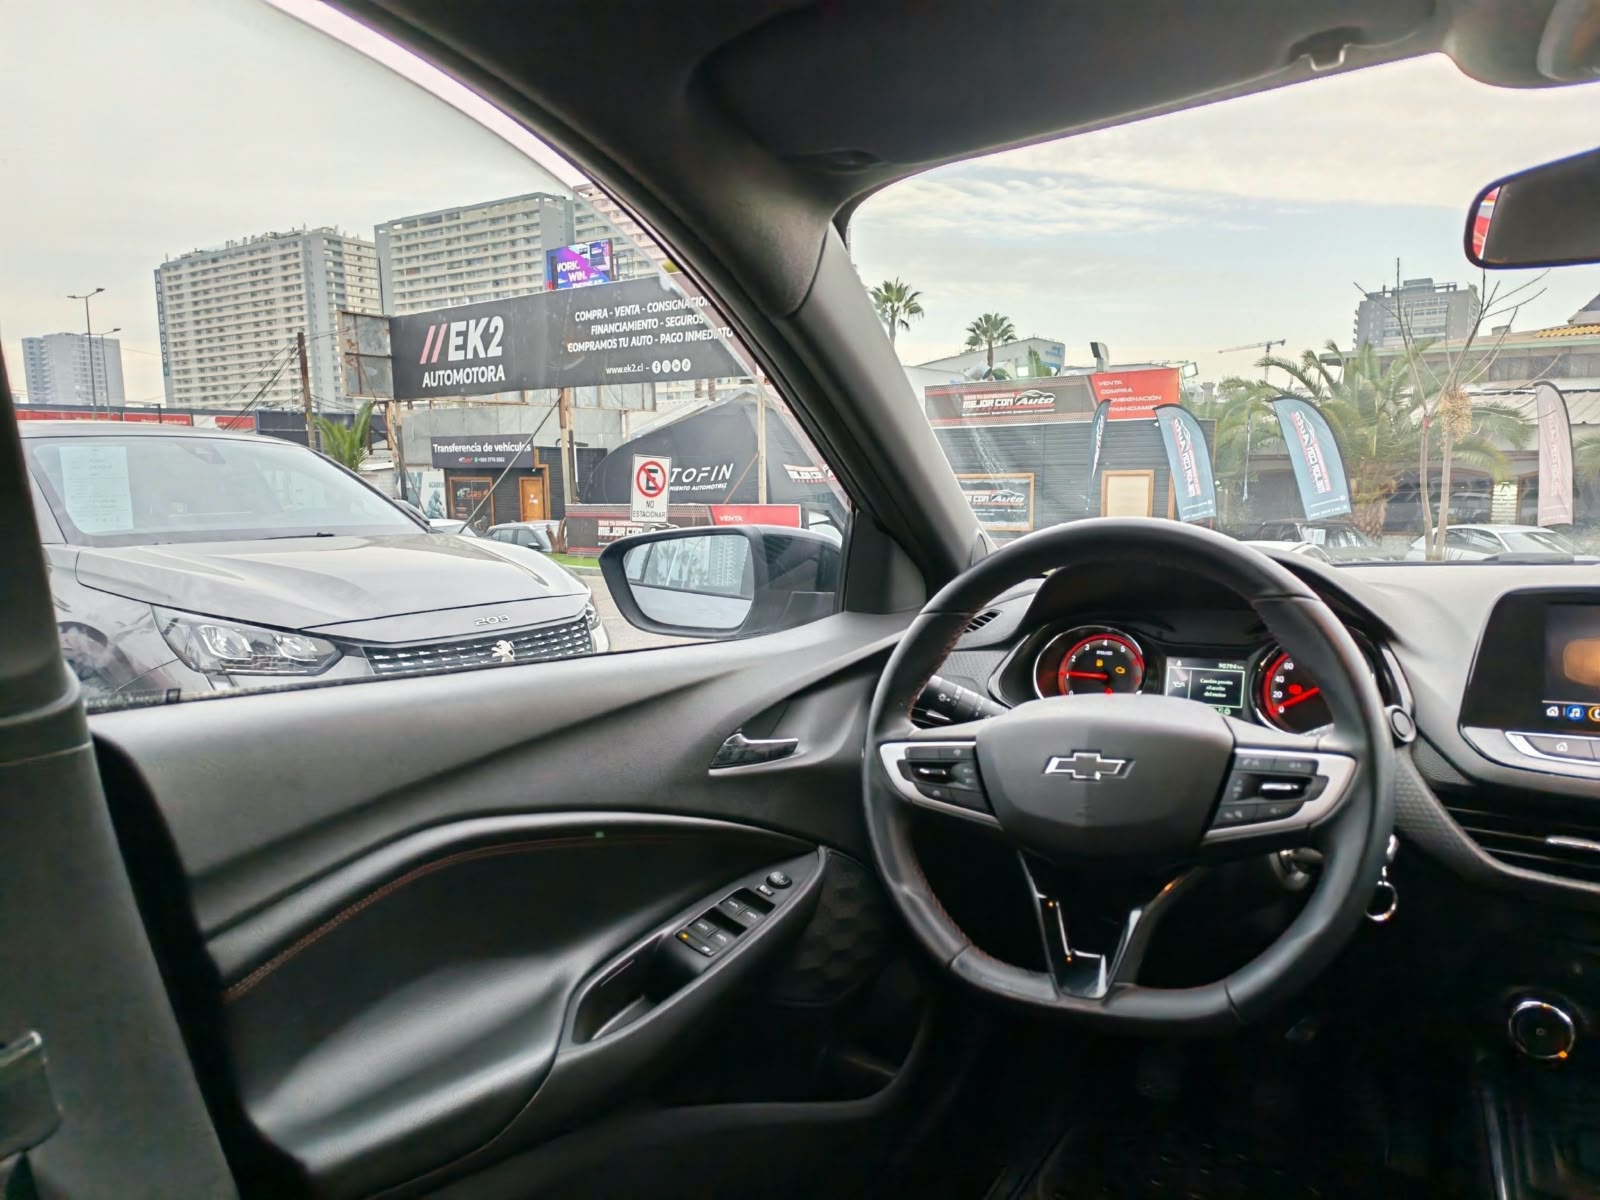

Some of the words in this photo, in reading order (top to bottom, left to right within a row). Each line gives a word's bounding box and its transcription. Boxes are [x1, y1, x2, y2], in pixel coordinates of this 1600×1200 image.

[575, 308, 608, 322] COMPRA
[614, 304, 640, 317] VENTA
[591, 318, 658, 335] FINANCIAMIENTO
[665, 314, 704, 327] SEGUROS
[568, 338, 617, 352] COMPRAMOS
[618, 337, 629, 348] TU
[630, 335, 653, 347] AUTO
[660, 332, 684, 344] PAGO
[606, 363, 643, 374] www.ek2.cl
[422, 364, 506, 388] AUTOMOTORA
[963, 400, 994, 408] MEJOR
[1015, 396, 1055, 406] Auto
[1110, 395, 1161, 403] ONSIGNACIÓN
[433, 443, 481, 453] Transferencia
[483, 443, 492, 452] de
[670, 463, 734, 482] TOFIN
[692, 483, 727, 491] AUTOMOTRIZ
[646, 500, 654, 508] NO
[474, 615, 510, 626] 208
[1279, 705, 1284, 713] 0
